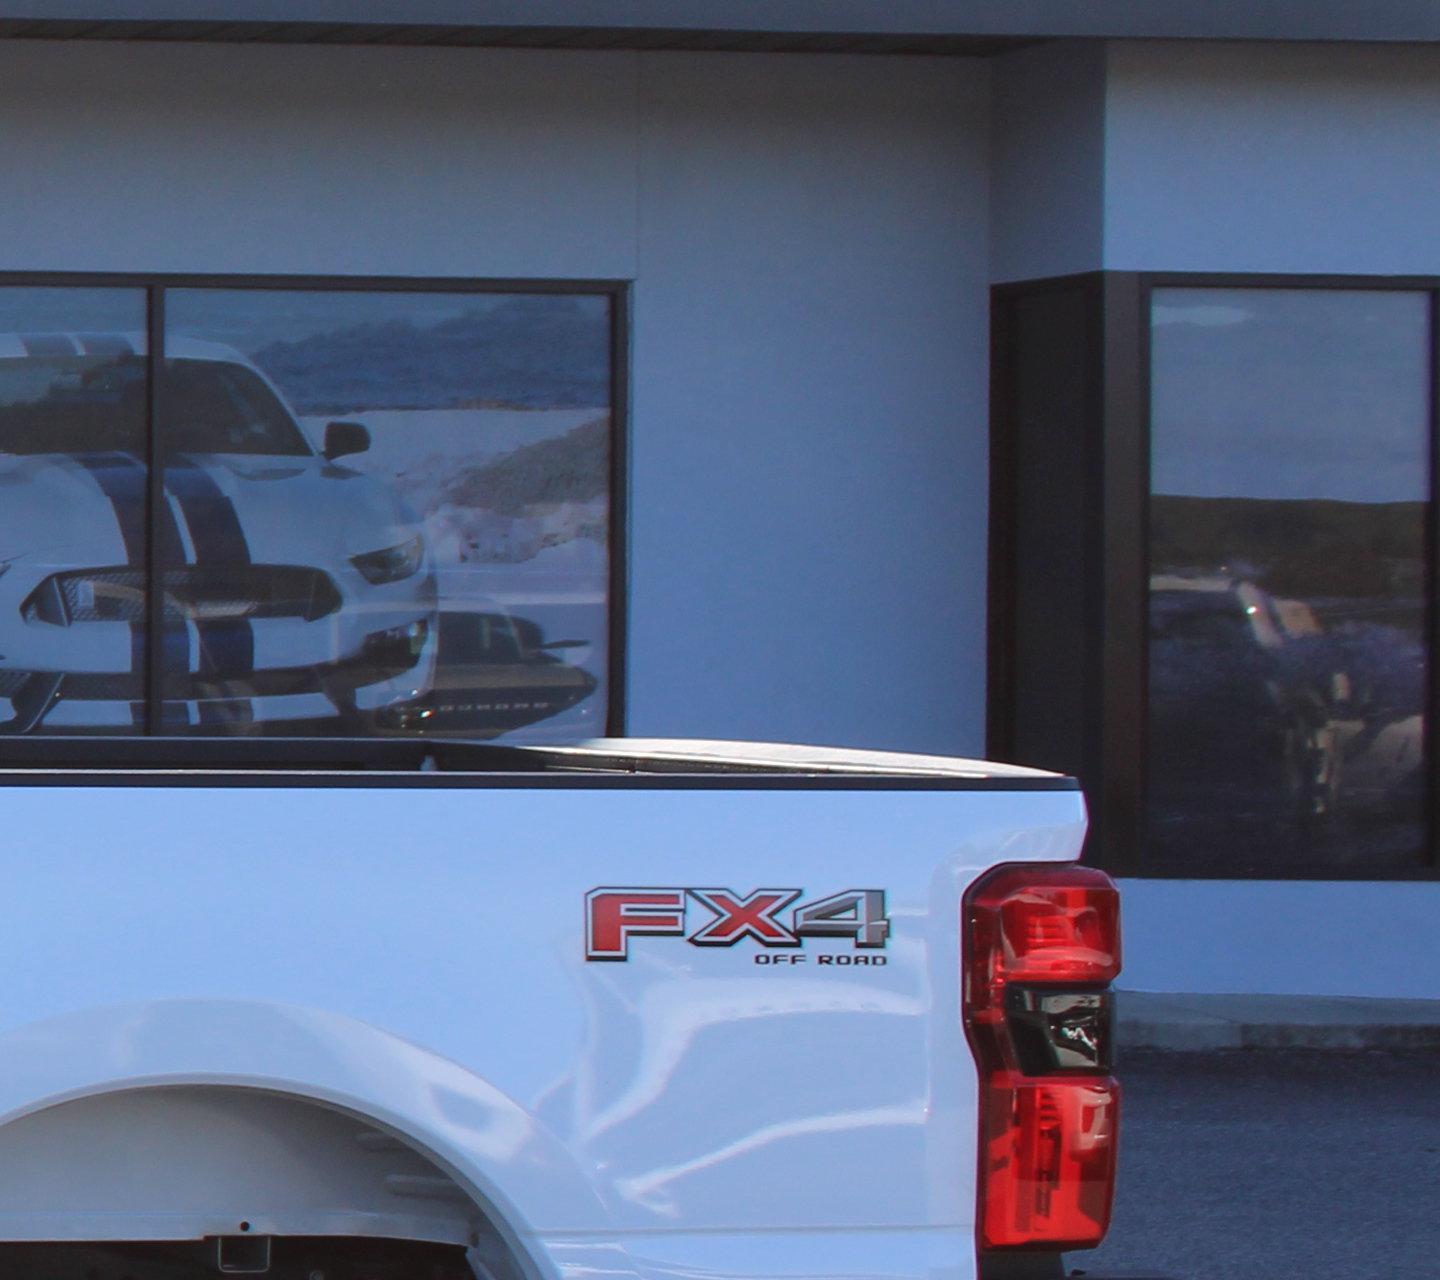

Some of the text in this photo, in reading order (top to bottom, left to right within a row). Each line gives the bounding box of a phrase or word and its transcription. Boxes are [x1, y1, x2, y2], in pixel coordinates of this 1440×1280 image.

[584, 886, 890, 962] FX4
[754, 954, 888, 967] OFF ROAD
